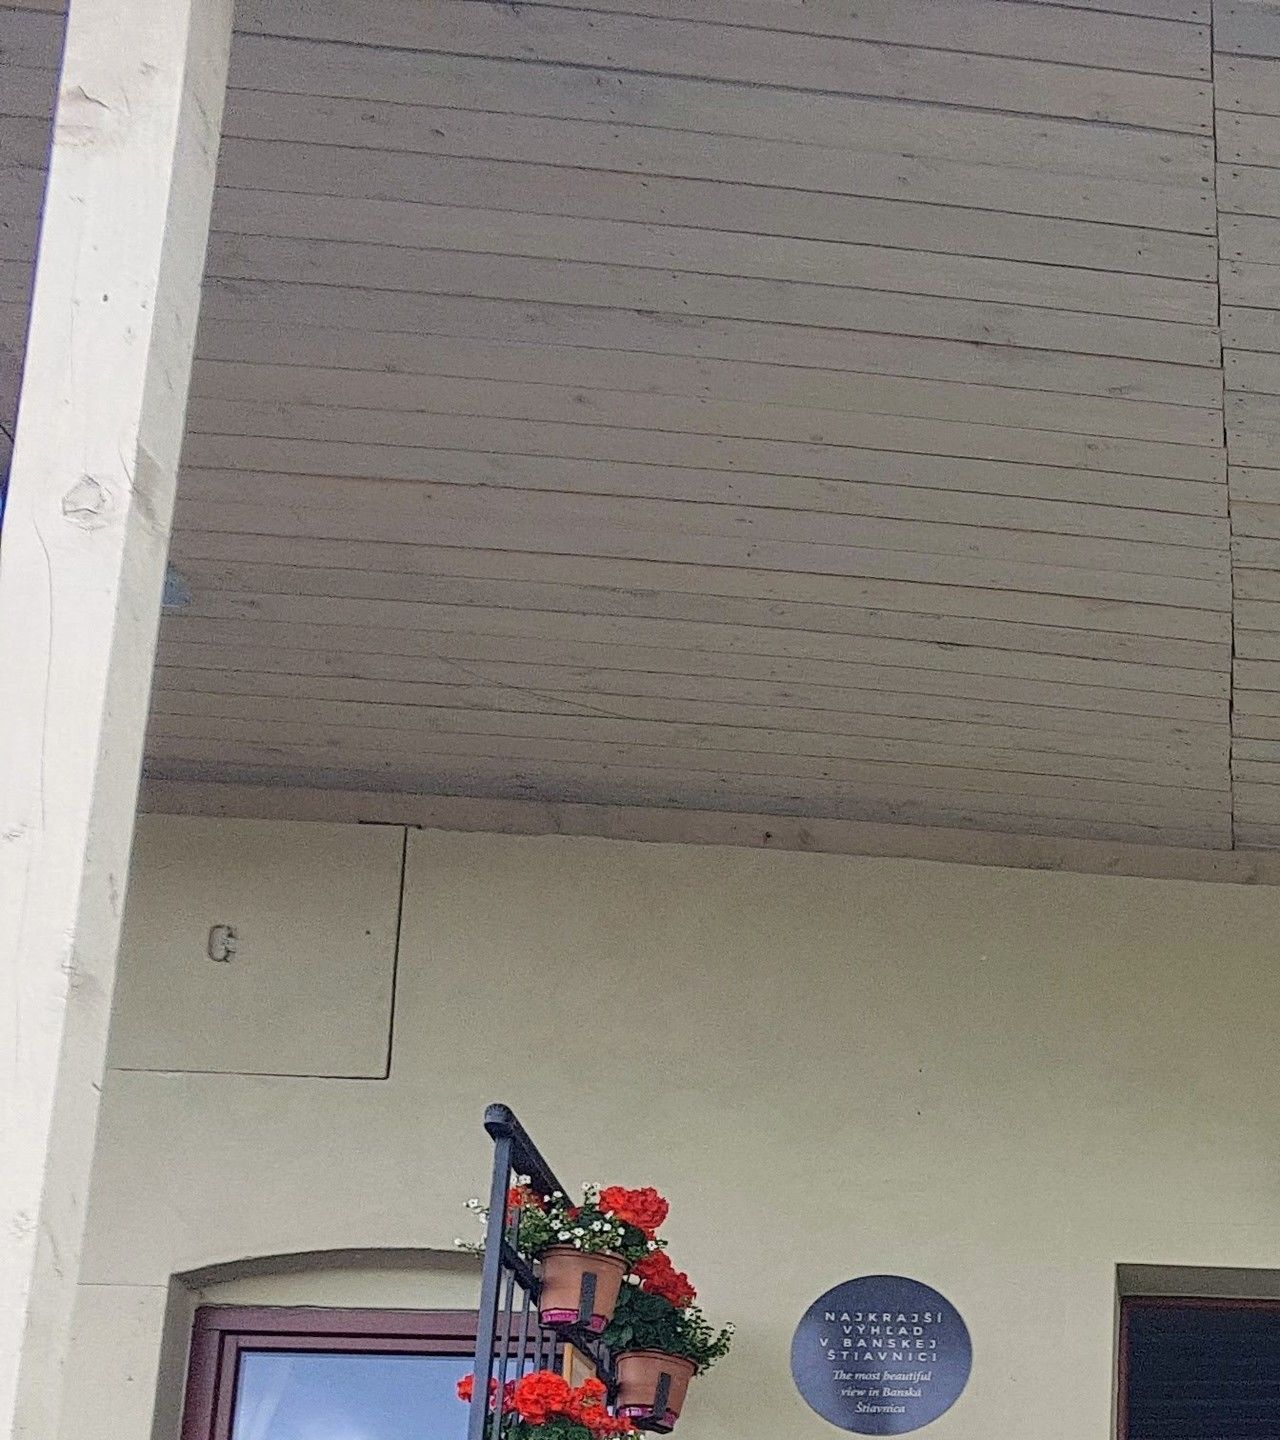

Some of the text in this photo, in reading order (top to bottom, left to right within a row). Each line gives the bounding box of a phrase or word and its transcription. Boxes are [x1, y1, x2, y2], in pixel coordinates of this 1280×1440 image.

[820, 1338, 937, 1349] V BANSKEJ
[828, 1349, 937, 1362] ŠTIAVNICI
[833, 1370, 932, 1384] The most beautiful
[841, 1386, 866, 1397] view
[869, 1386, 880, 1396] in
